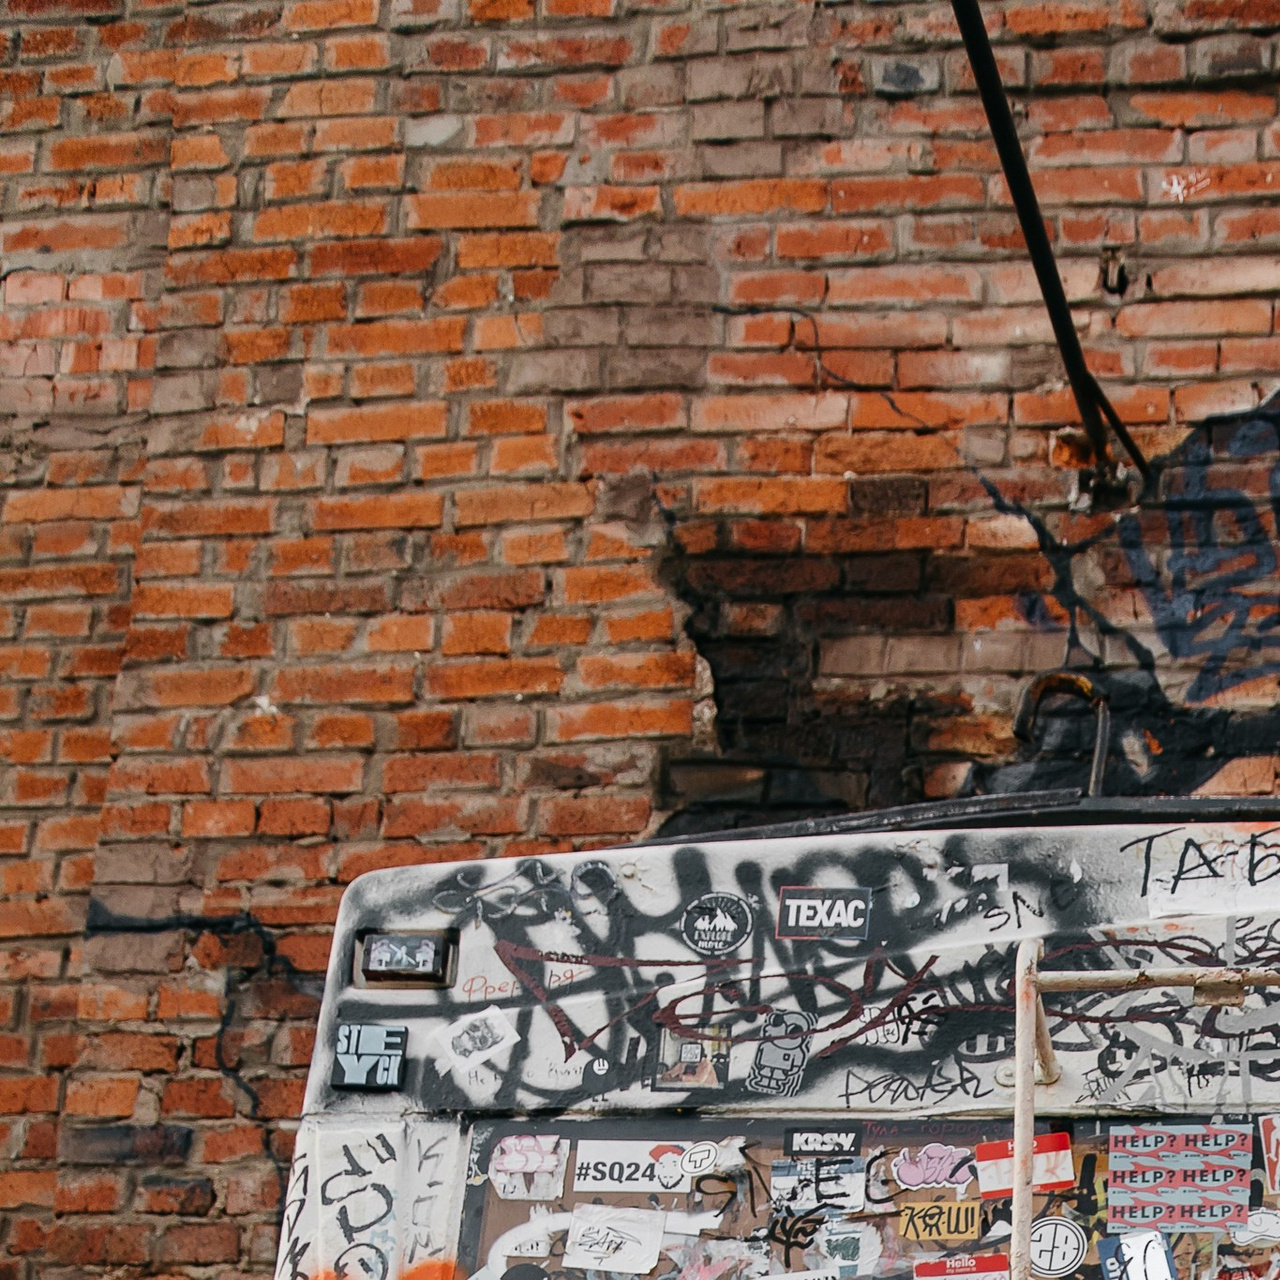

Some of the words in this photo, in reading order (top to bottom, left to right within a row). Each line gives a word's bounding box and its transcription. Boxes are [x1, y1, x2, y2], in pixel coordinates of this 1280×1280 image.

[1114, 1135, 1177, 1149] HELP?
[1185, 1133, 1248, 1147] HELP?
[576, 1162, 657, 1184] #SQ24
[1112, 1170, 1176, 1184] HELP?
[1183, 1168, 1246, 1183] HELP?
[1112, 1205, 1176, 1219] HELP?
[1181, 1204, 1244, 1218] HELP?
[946, 1258, 977, 1269] Hello
